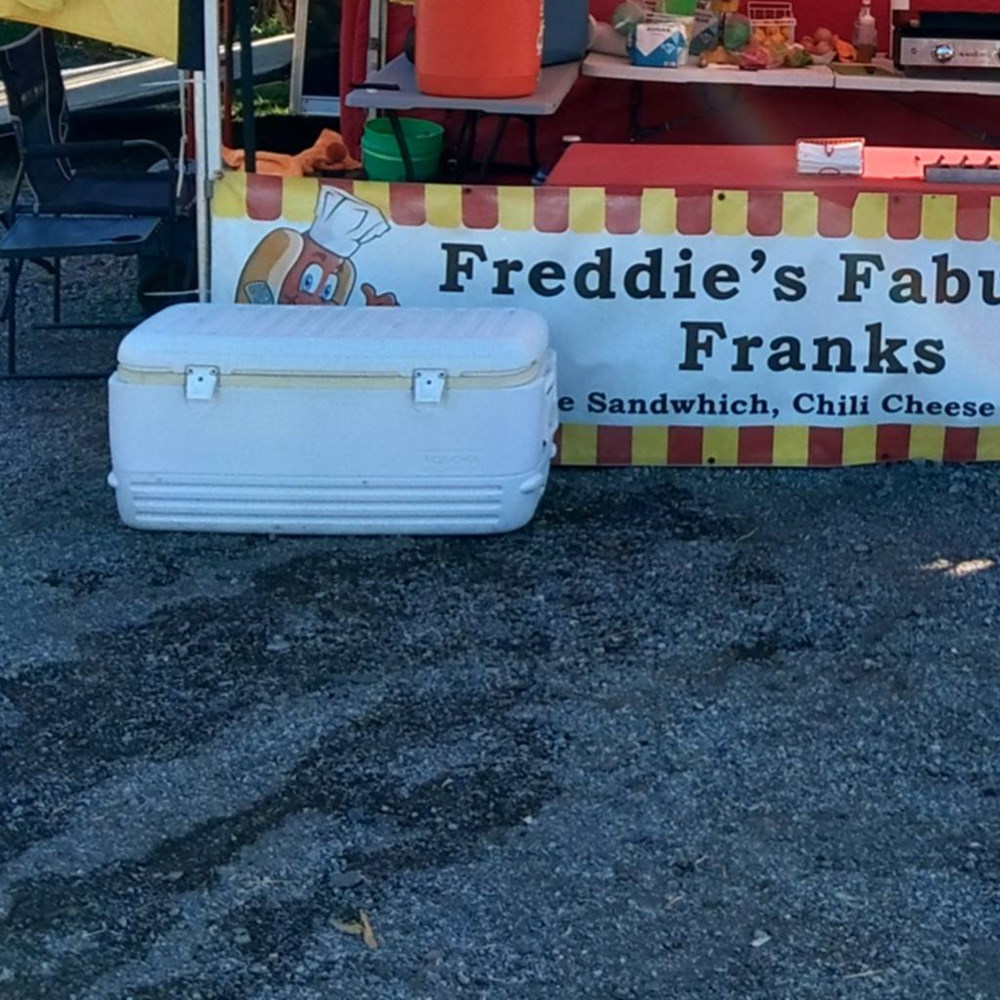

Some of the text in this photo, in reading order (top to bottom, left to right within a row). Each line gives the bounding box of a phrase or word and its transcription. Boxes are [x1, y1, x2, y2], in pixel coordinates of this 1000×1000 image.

[678, 321, 946, 375] Franks
[587, 391, 779, 418] Sandwhich,
[792, 393, 870, 416] Chili
[881, 393, 996, 417] Cheese
